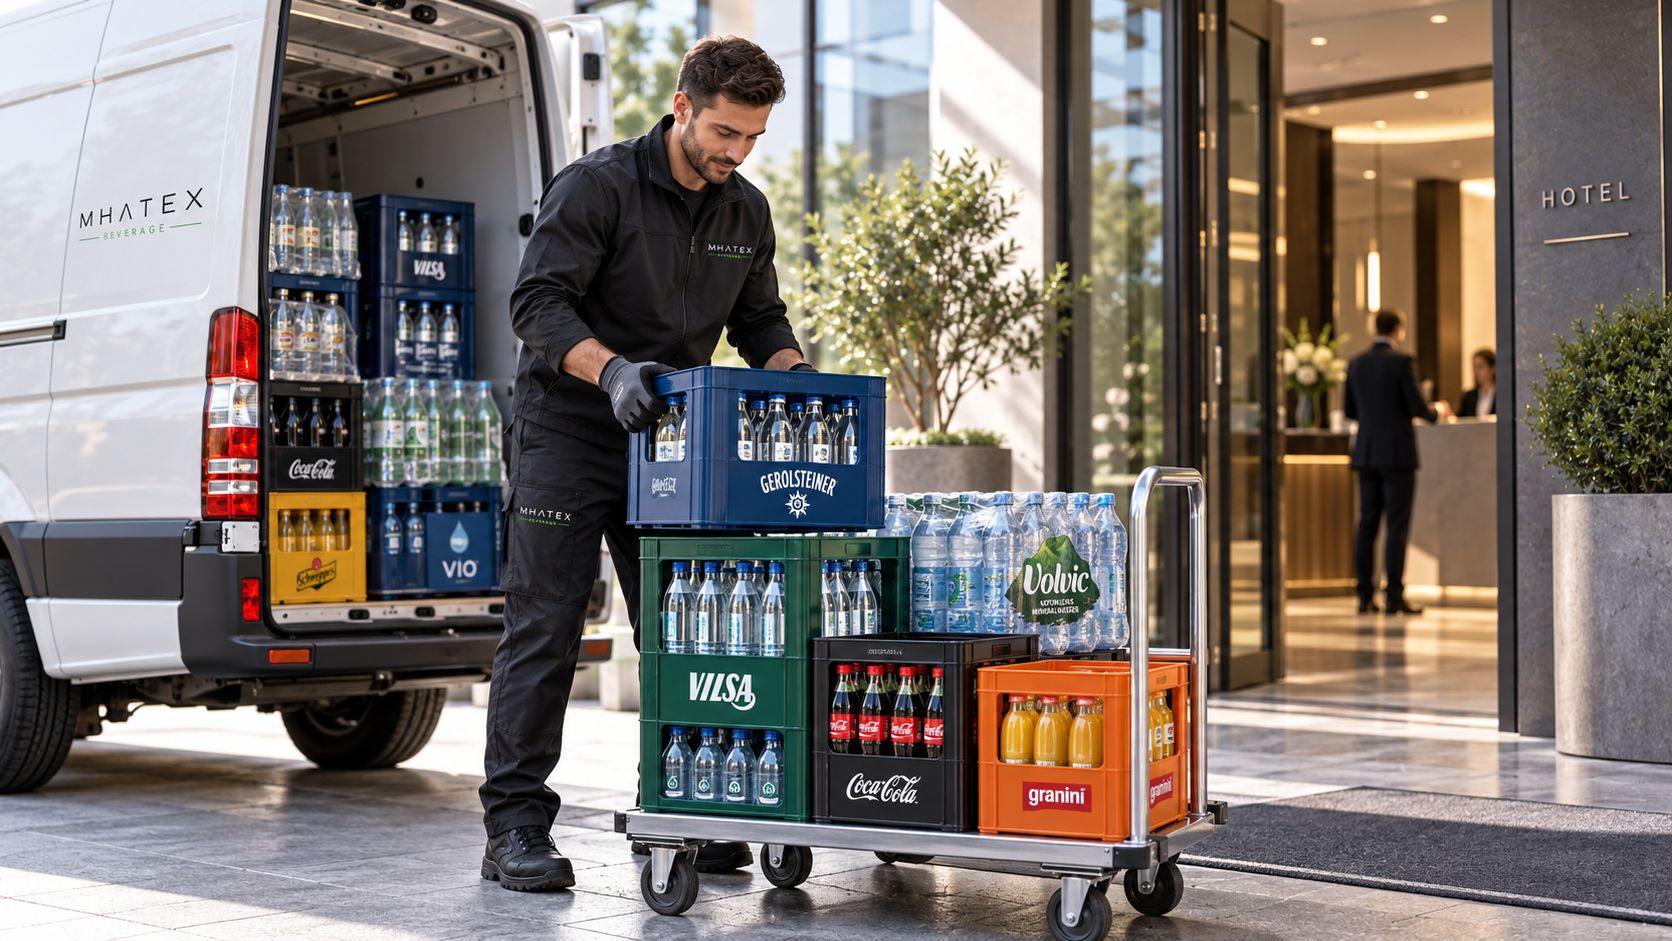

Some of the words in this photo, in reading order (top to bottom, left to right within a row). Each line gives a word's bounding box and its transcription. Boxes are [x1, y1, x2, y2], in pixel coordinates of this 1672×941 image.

[1542, 181, 1630, 209] HOTEL
[103, 223, 165, 240] BEVERAGE
[414, 259, 446, 281] VILSA
[760, 469, 837, 497] GEROLSTEINER
[441, 559, 478, 579] VIO
[1023, 562, 1090, 596] Volvic
[689, 671, 756, 711] VILSA
[846, 772, 922, 804] Coca-Cola
[1028, 786, 1086, 806] granini
